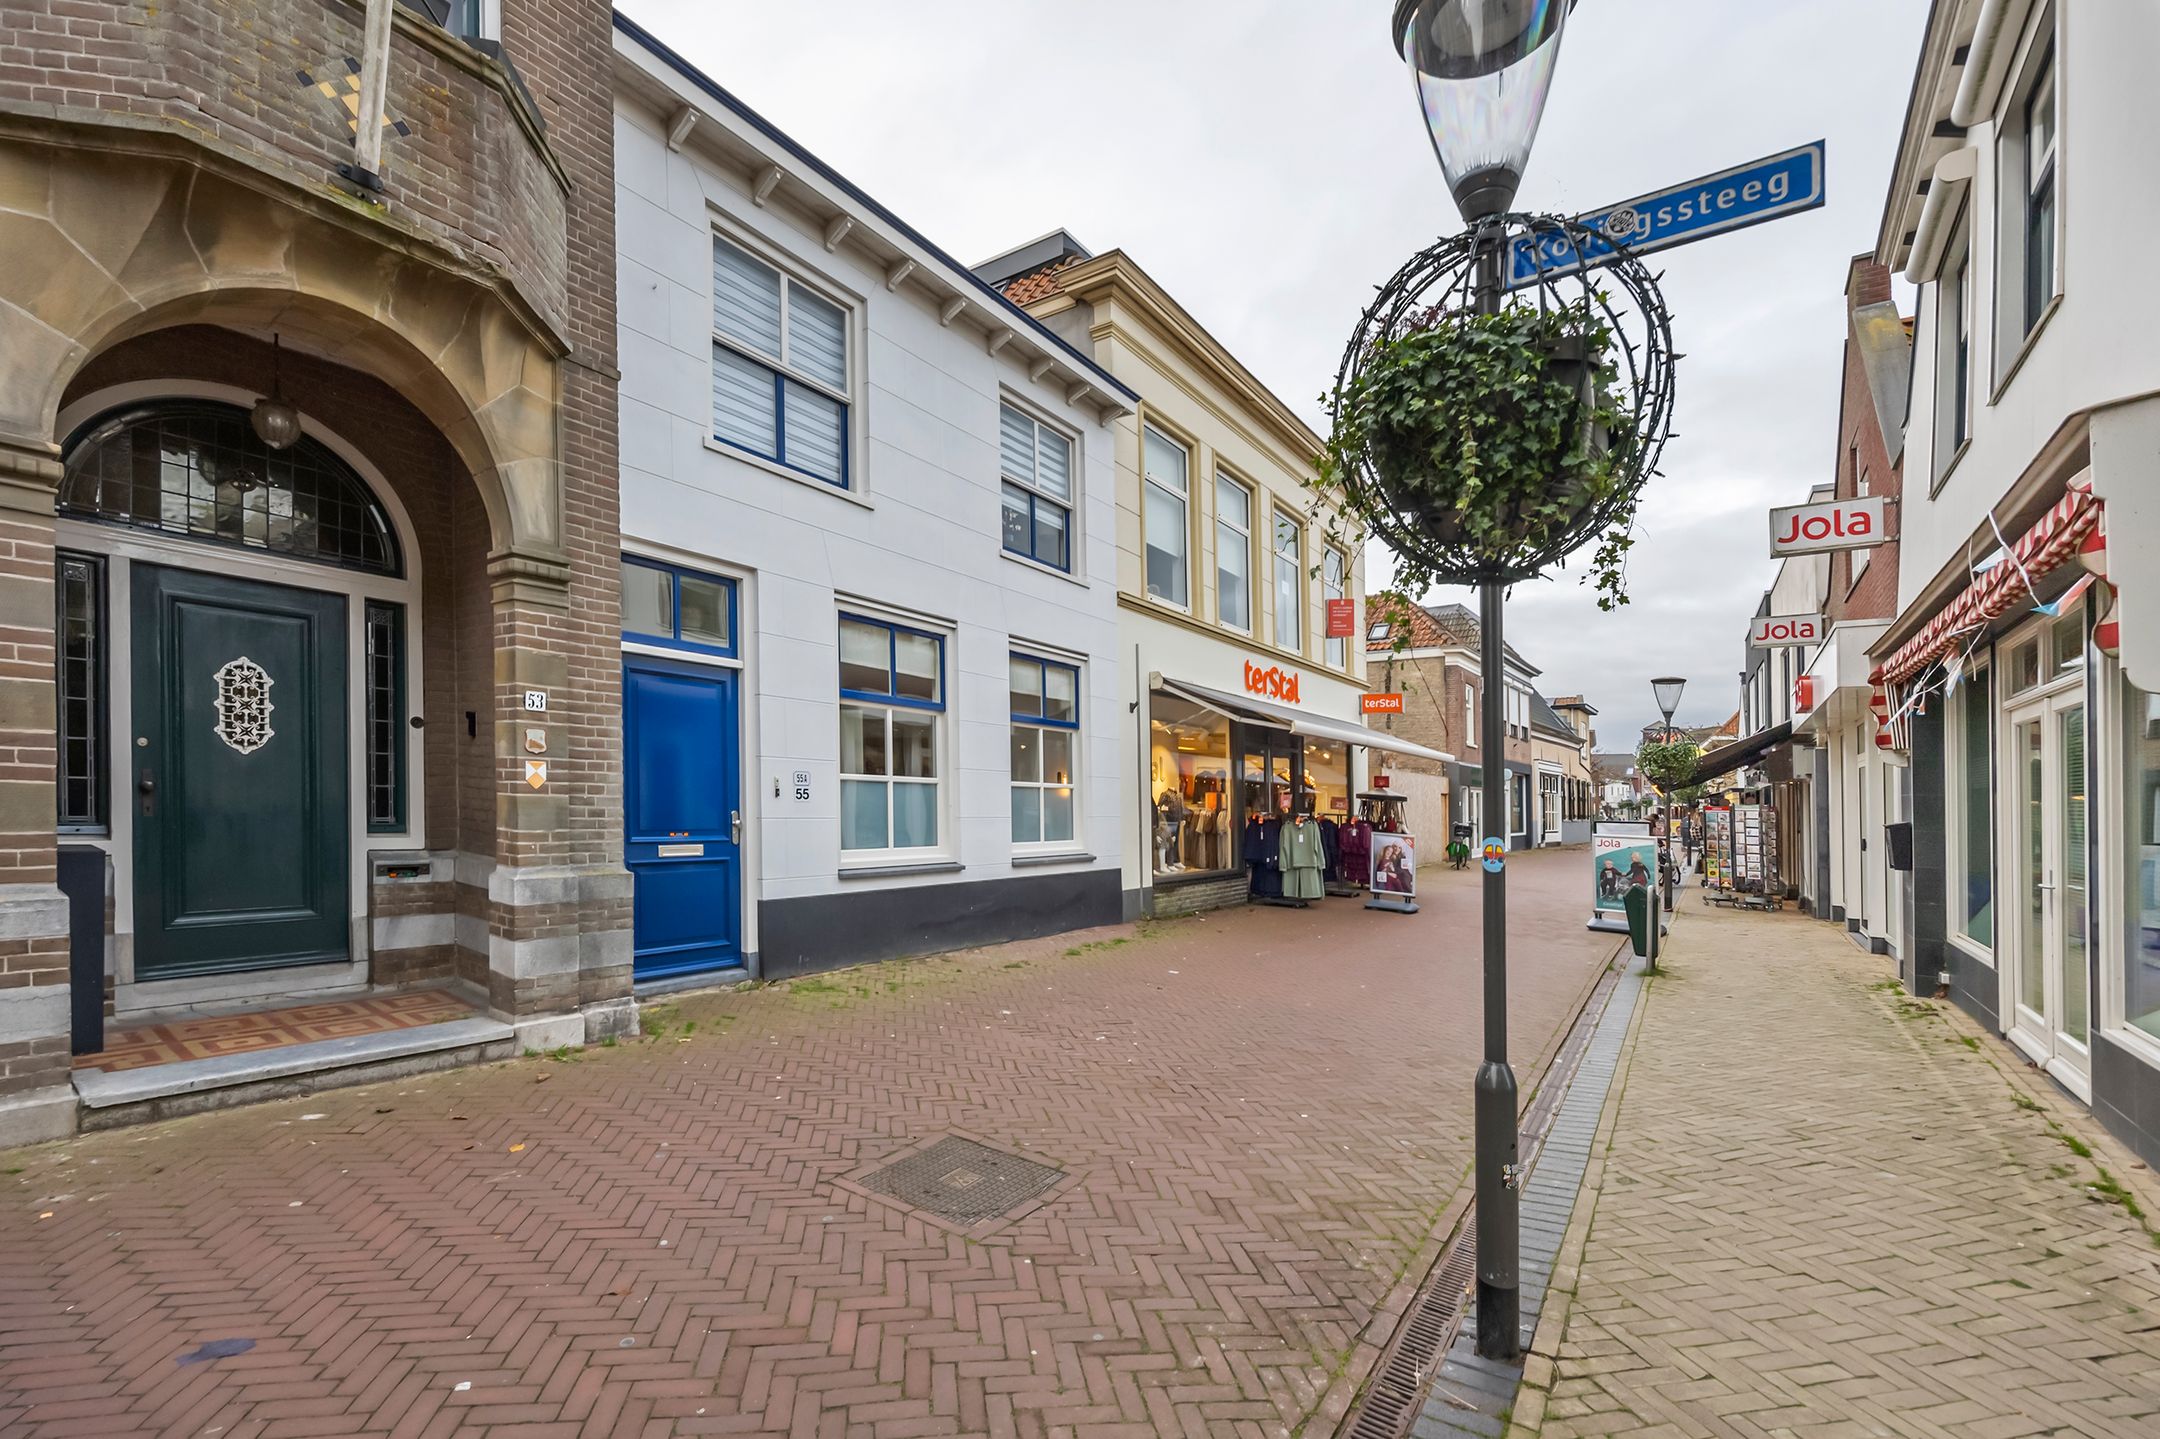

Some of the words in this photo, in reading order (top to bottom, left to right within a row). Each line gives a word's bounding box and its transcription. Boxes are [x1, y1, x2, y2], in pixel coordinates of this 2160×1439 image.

[1777, 509, 1871, 544] Jola
[1755, 620, 1815, 641] Jola
[1244, 659, 1301, 704] terStal
[528, 693, 544, 708] 53
[1365, 698, 1400, 708] terStal
[795, 788, 810, 800] 55
[1597, 839, 1621, 848] Jola
